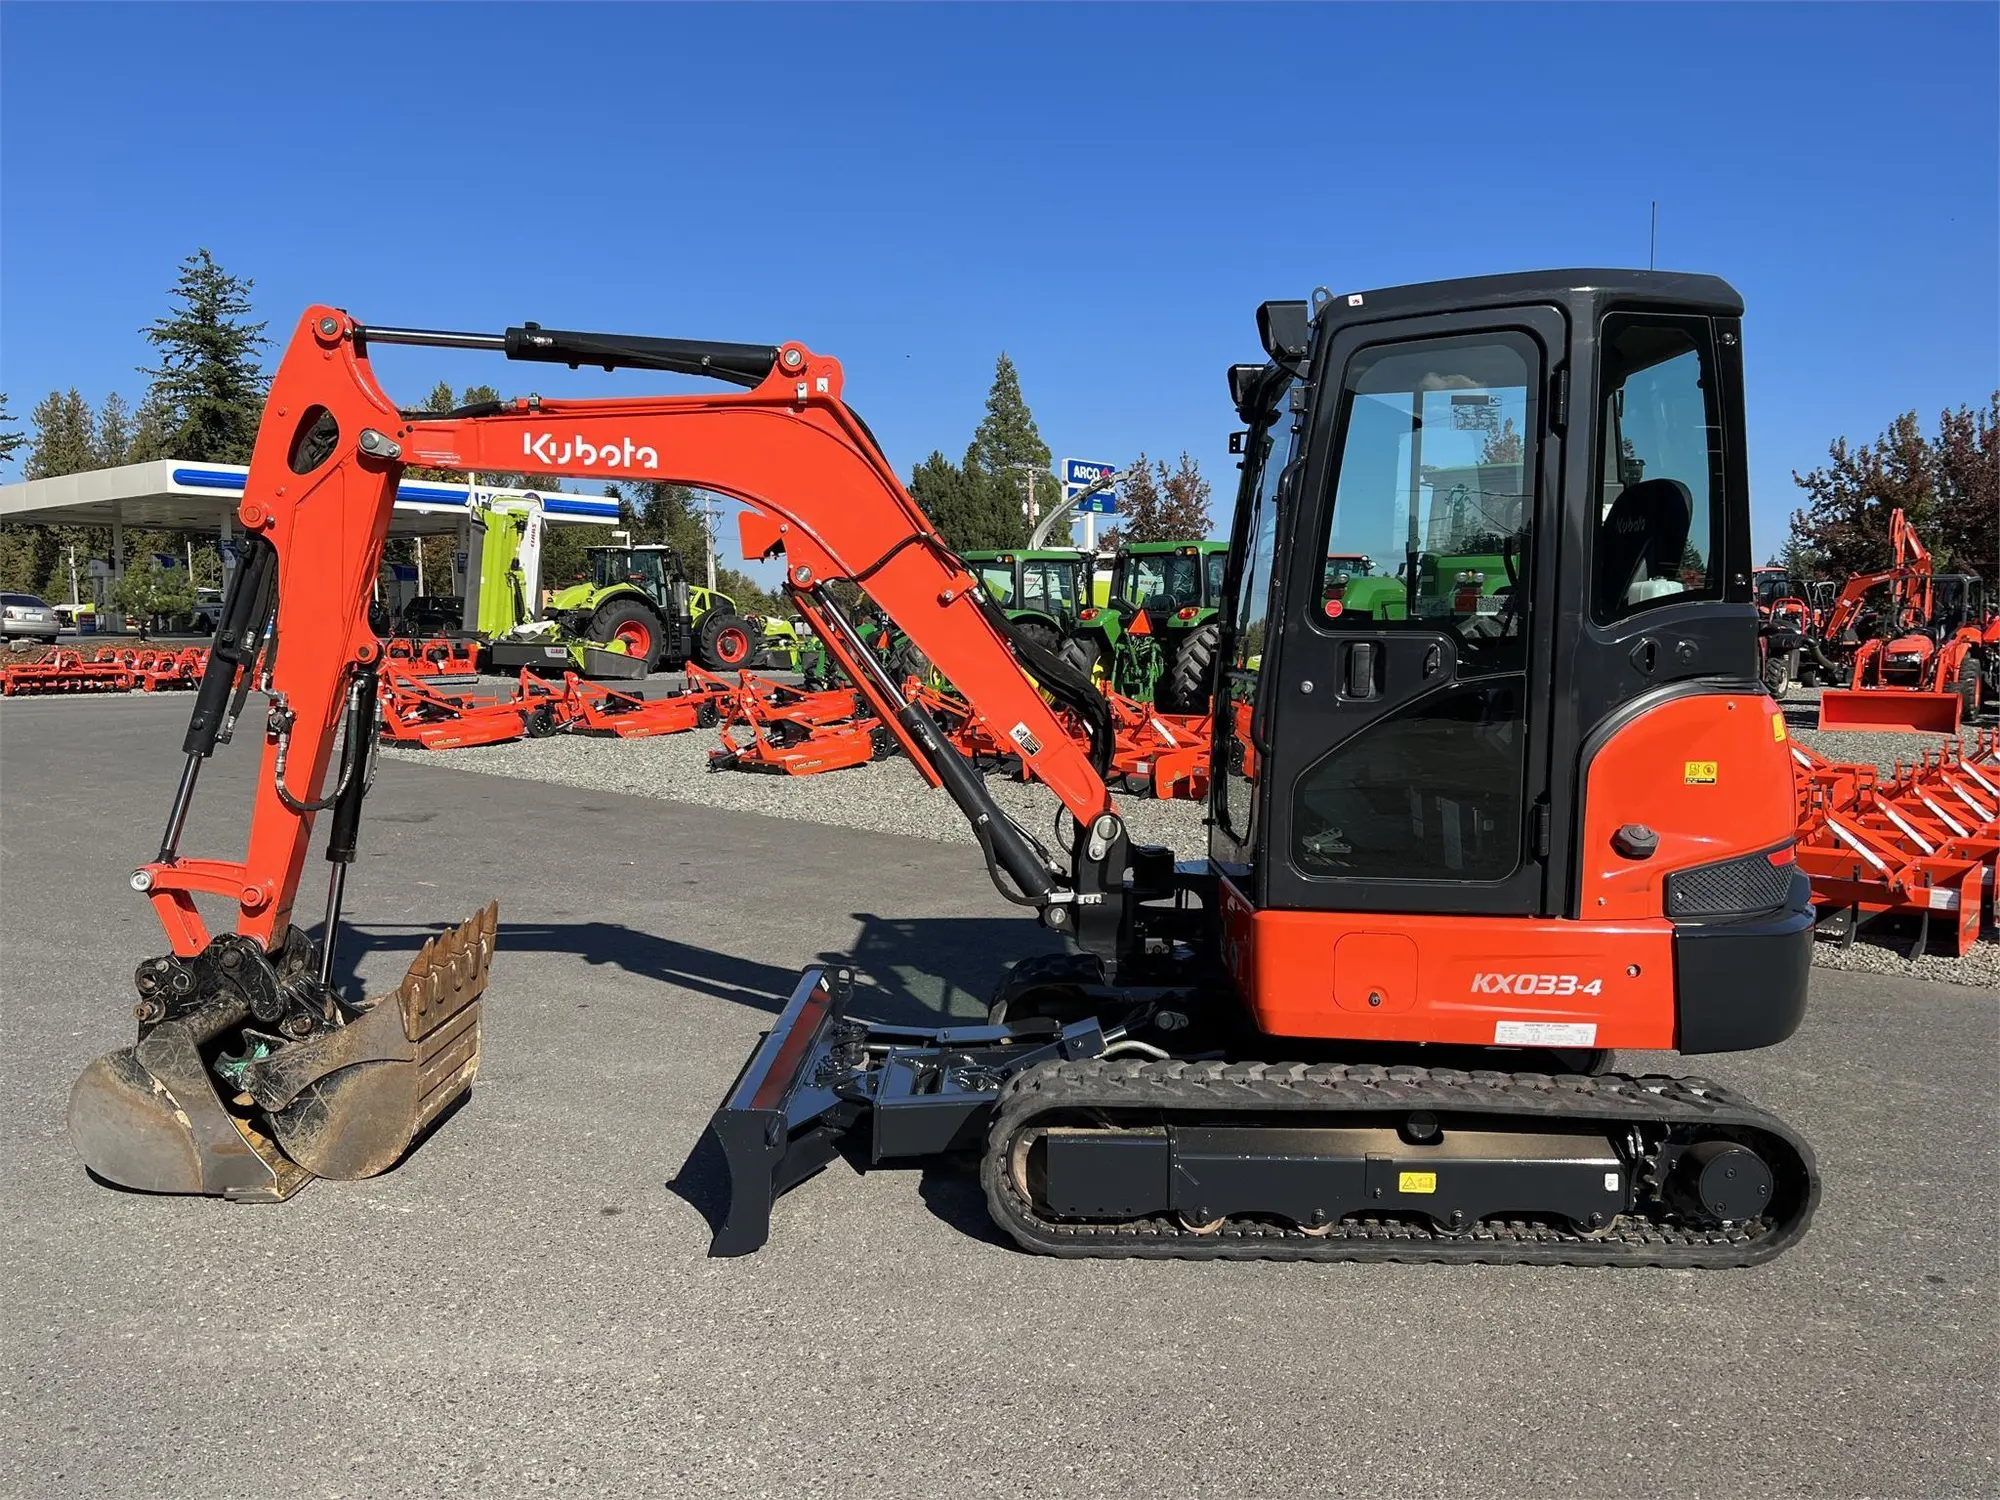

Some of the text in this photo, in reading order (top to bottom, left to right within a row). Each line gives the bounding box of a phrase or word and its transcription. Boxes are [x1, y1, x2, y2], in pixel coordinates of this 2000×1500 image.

[523, 432, 658, 469] Kubota
[1073, 464, 1100, 481] ARCO
[1471, 972, 1603, 996] KX033-4
